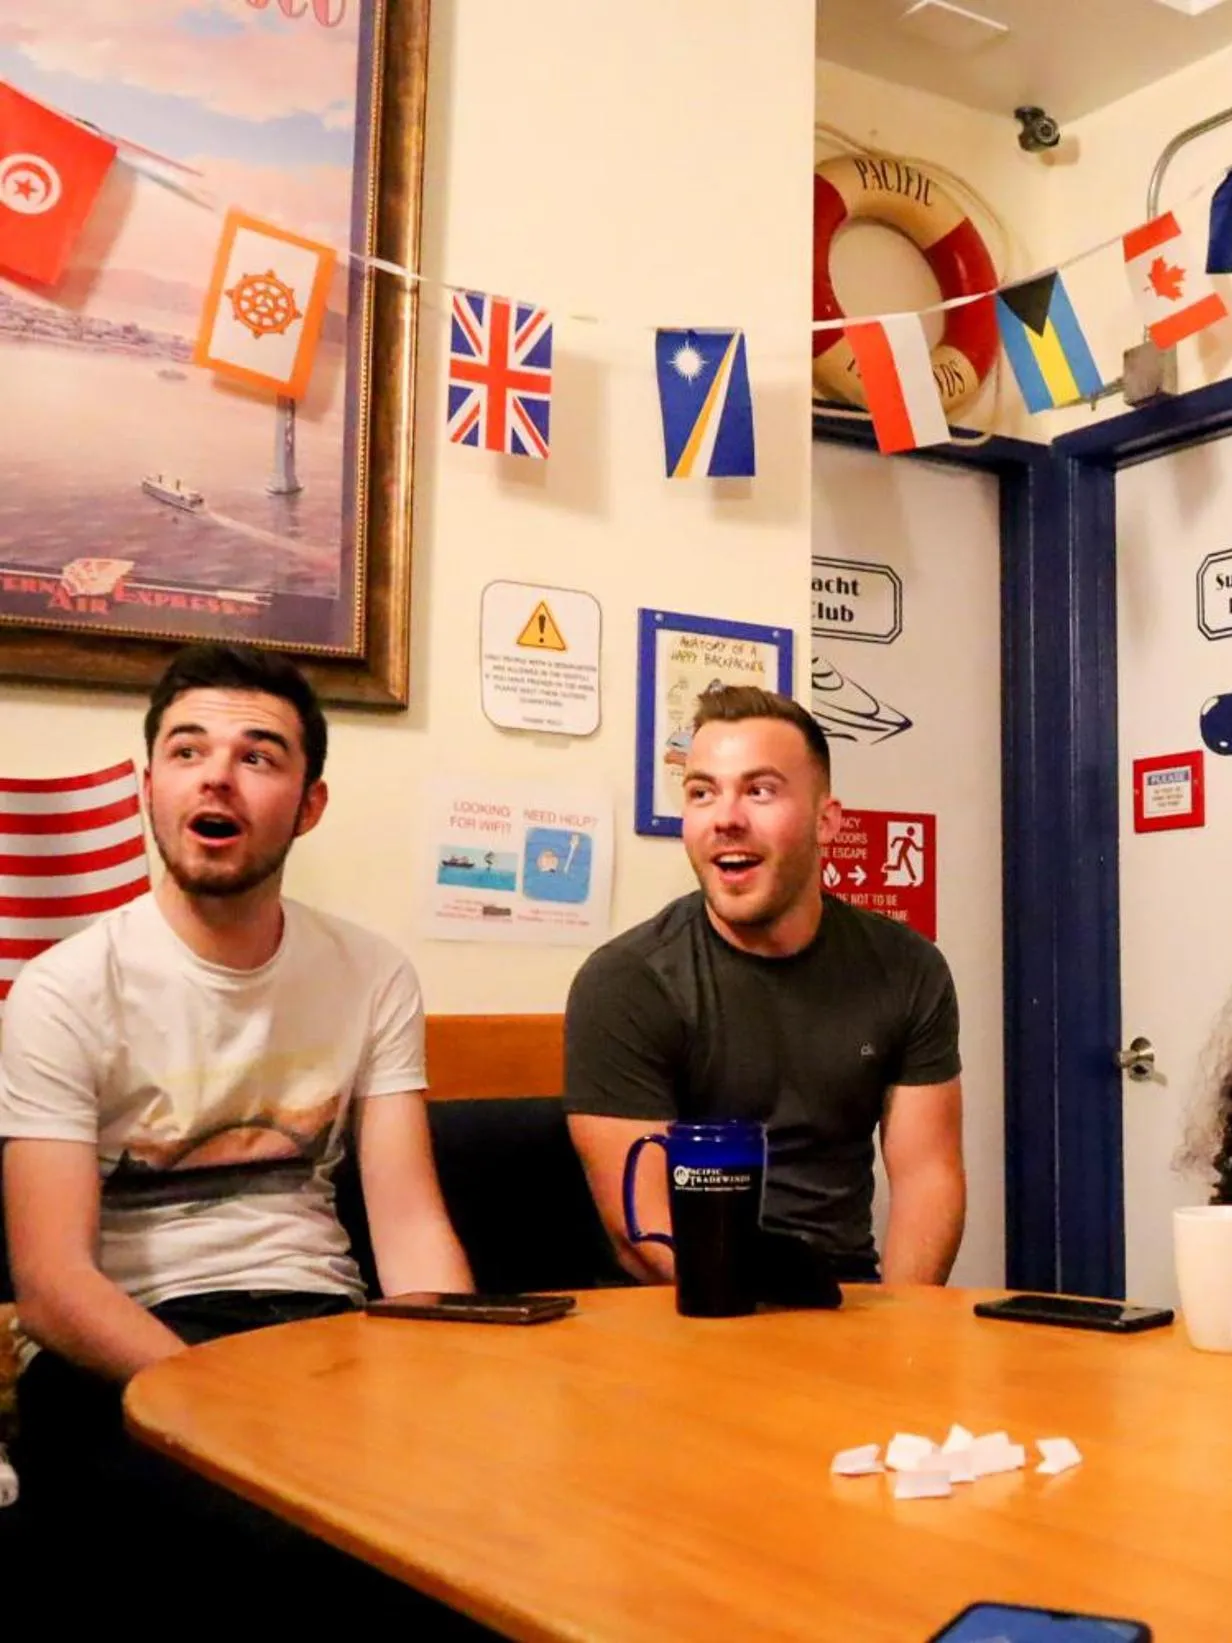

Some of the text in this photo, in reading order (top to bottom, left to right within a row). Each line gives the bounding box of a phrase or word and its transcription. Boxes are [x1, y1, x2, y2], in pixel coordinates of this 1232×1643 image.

[853, 157, 938, 208] PACIFIC
[811, 577, 860, 597] acht
[811, 602, 855, 623] lub
[453, 801, 512, 819] LOOKING
[524, 809, 599, 828] NEED HELP?
[450, 816, 477, 830] FOR
[832, 847, 868, 860] ESCAPE
[850, 893, 869, 906] NOT
[872, 894, 885, 906] TO
